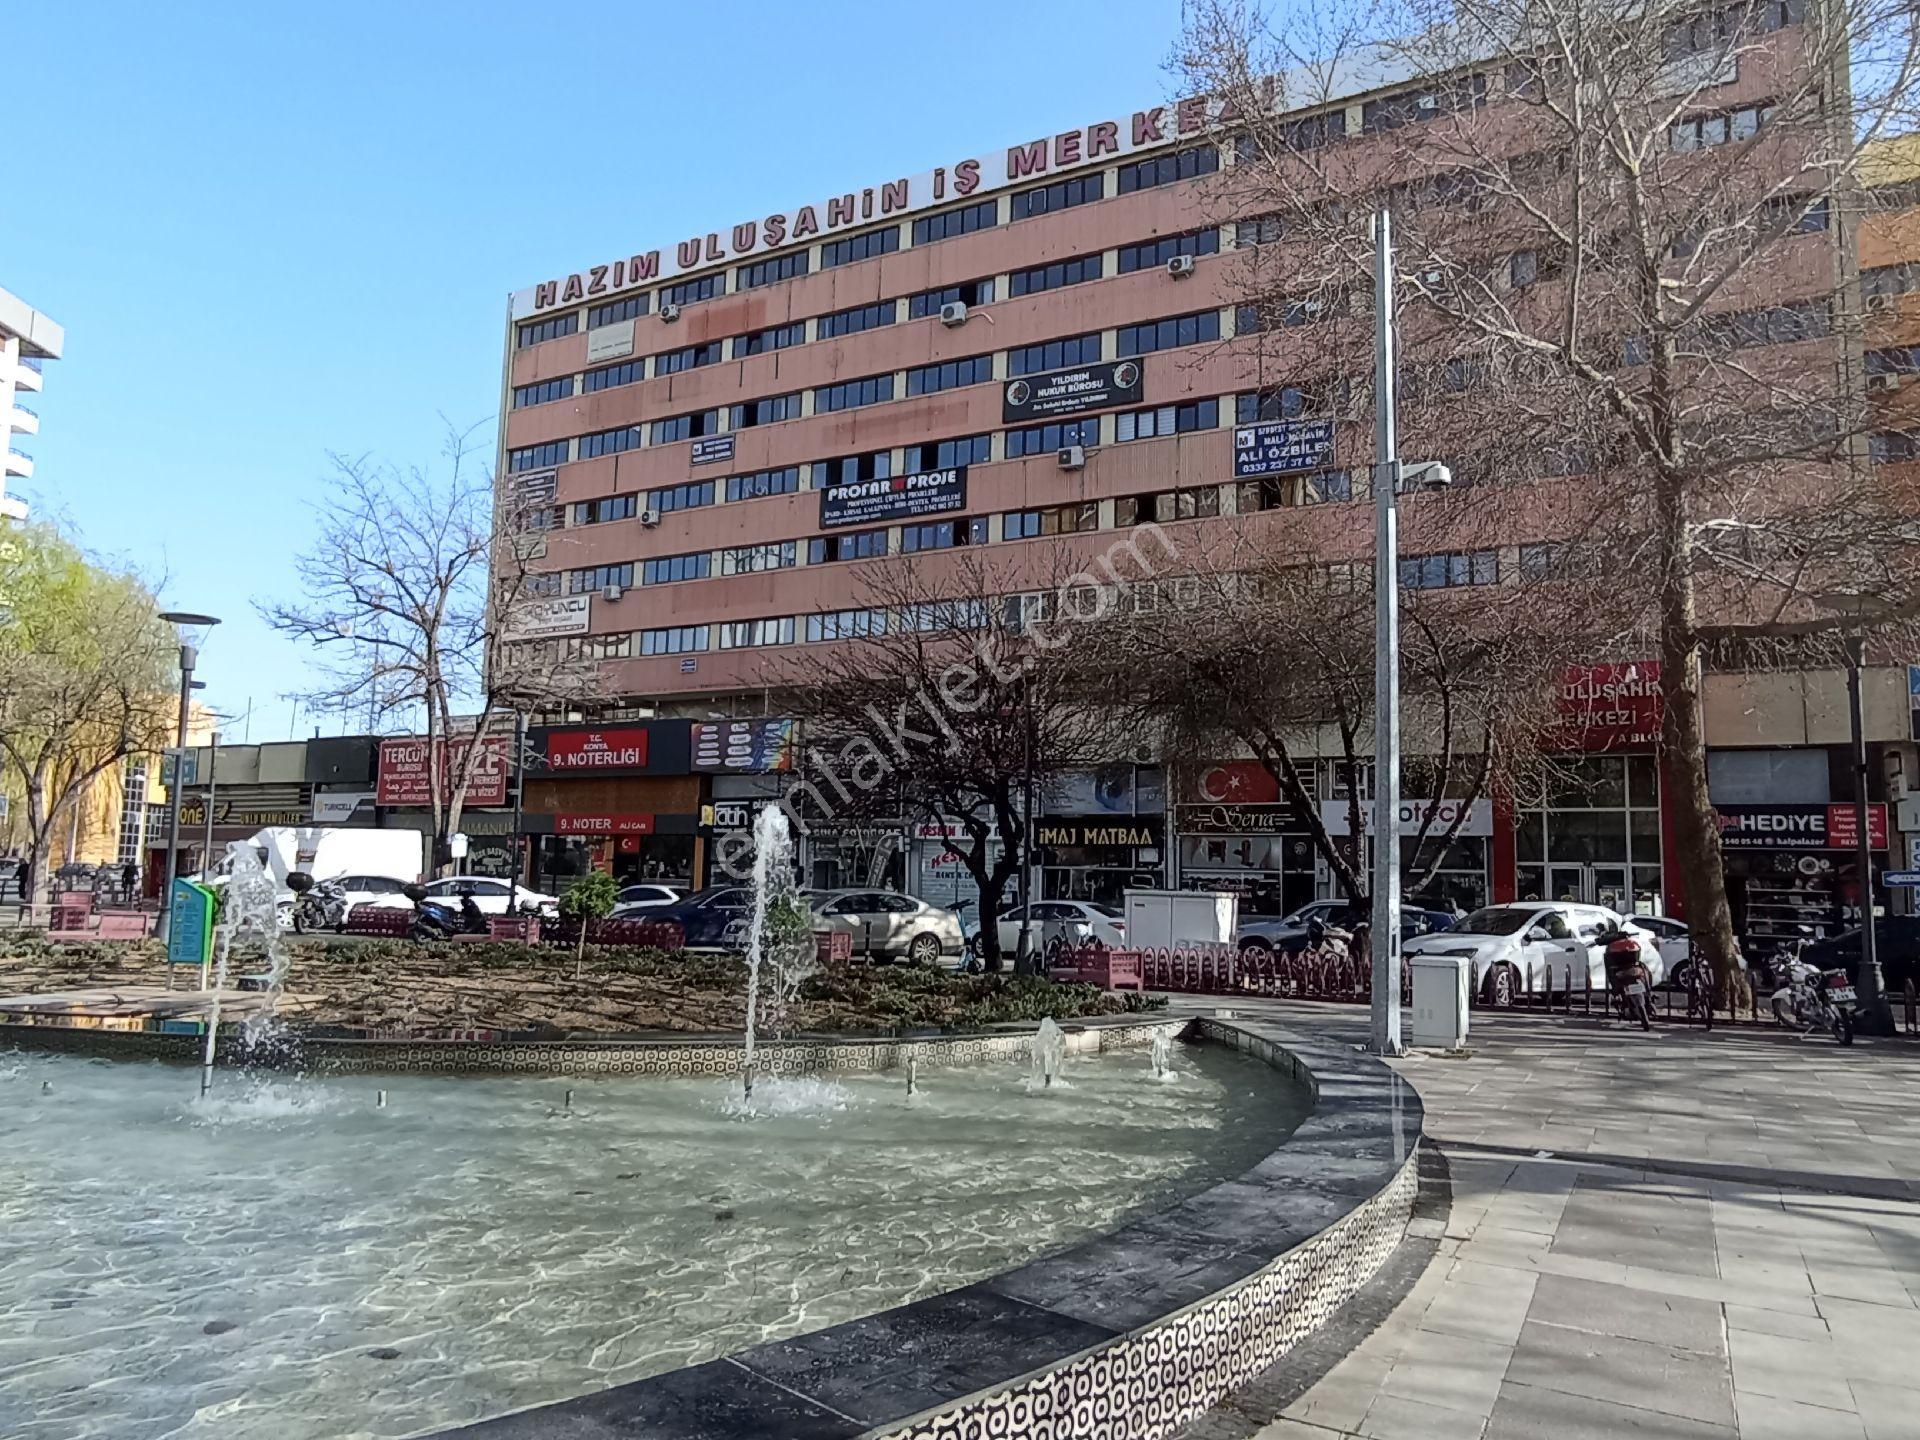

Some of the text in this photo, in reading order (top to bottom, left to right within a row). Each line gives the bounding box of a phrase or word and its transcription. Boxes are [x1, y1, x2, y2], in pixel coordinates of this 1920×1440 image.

[535, 250, 660, 309] HAZIM
[677, 179, 908, 270] ULUŞAHİN
[933, 159, 980, 199] İŞ
[1050, 372, 1091, 386] YILDIRIM
[1068, 379, 1104, 392] BÜROSU
[906, 470, 957, 490] PROJE
[384, 746, 430, 763] TERCÜM
[583, 743, 609, 751] KONYA
[553, 748, 640, 766] 9. NOTERLİĞİ
[560, 818, 570, 830] 9.
[573, 818, 612, 830] NOTER
[1211, 806, 1275, 828] Serra
[1740, 814, 1826, 832] HEDİYE
[1039, 828, 1153, 845] İMAJ MATBAA
